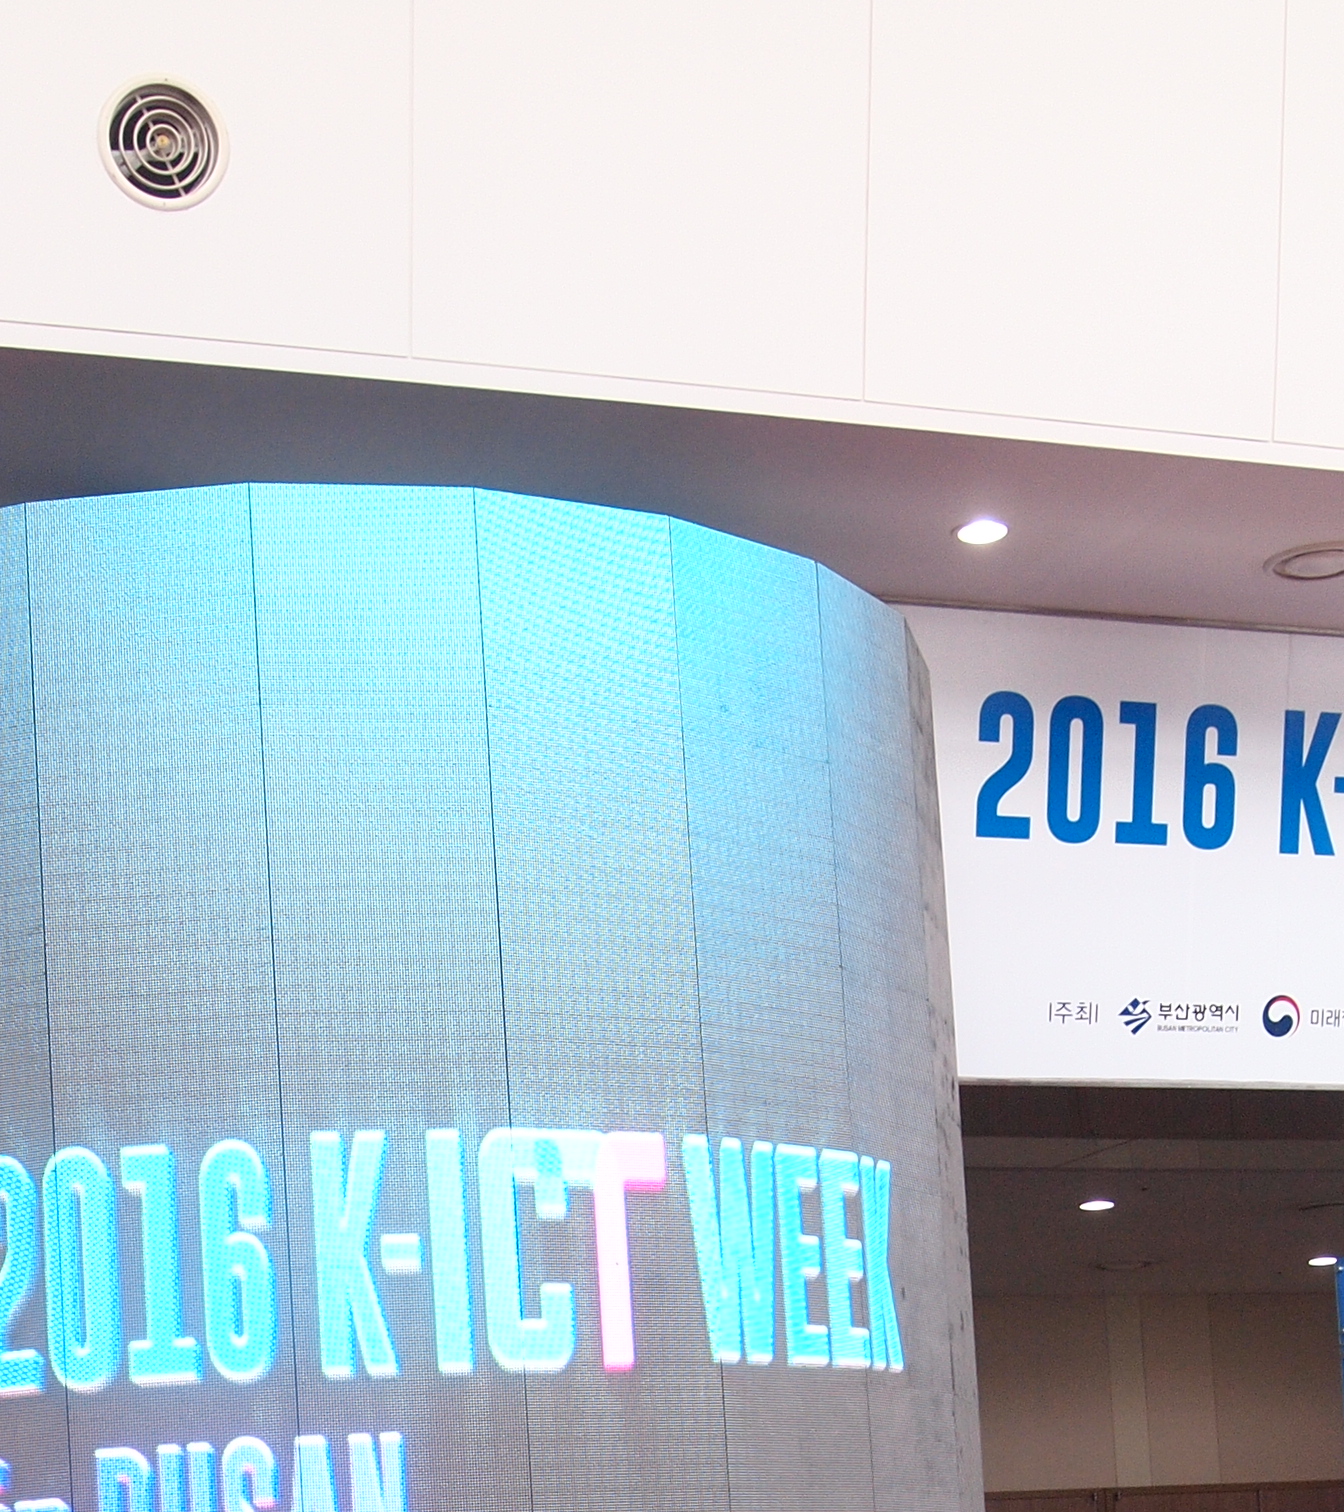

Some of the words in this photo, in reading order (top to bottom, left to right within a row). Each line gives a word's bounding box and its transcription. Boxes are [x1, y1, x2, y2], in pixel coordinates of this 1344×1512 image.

[976, 690, 1238, 851] 2016
[1158, 1002, 1240, 1022] 부산광역시
[309, 1126, 667, 1381] K-ICT
[681, 1132, 905, 1373] WEEK
